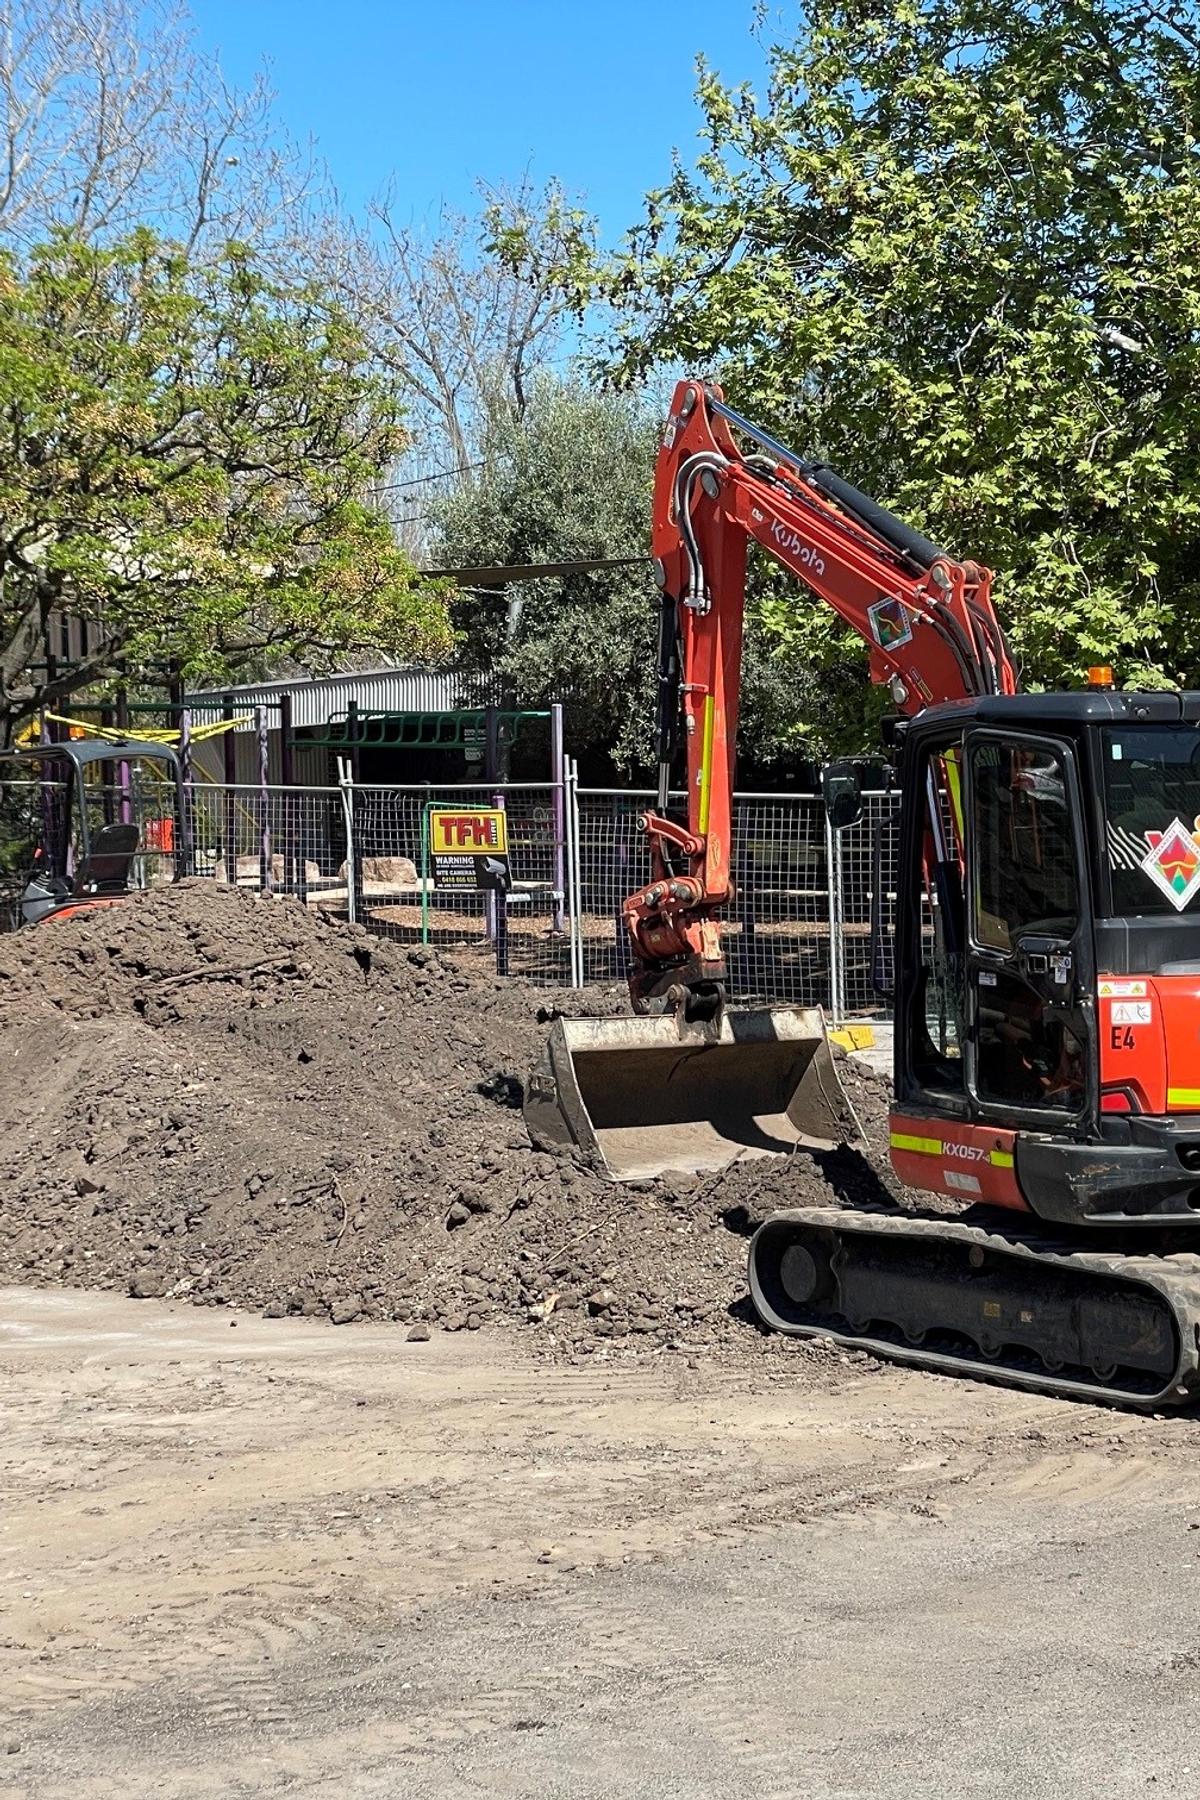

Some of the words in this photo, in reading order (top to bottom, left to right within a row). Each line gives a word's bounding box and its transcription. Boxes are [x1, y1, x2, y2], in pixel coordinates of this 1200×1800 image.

[771, 518, 825, 576] Kubota
[439, 817, 491, 846] TFH
[435, 856, 474, 864] WARNING
[1111, 1026, 1135, 1050] E4
